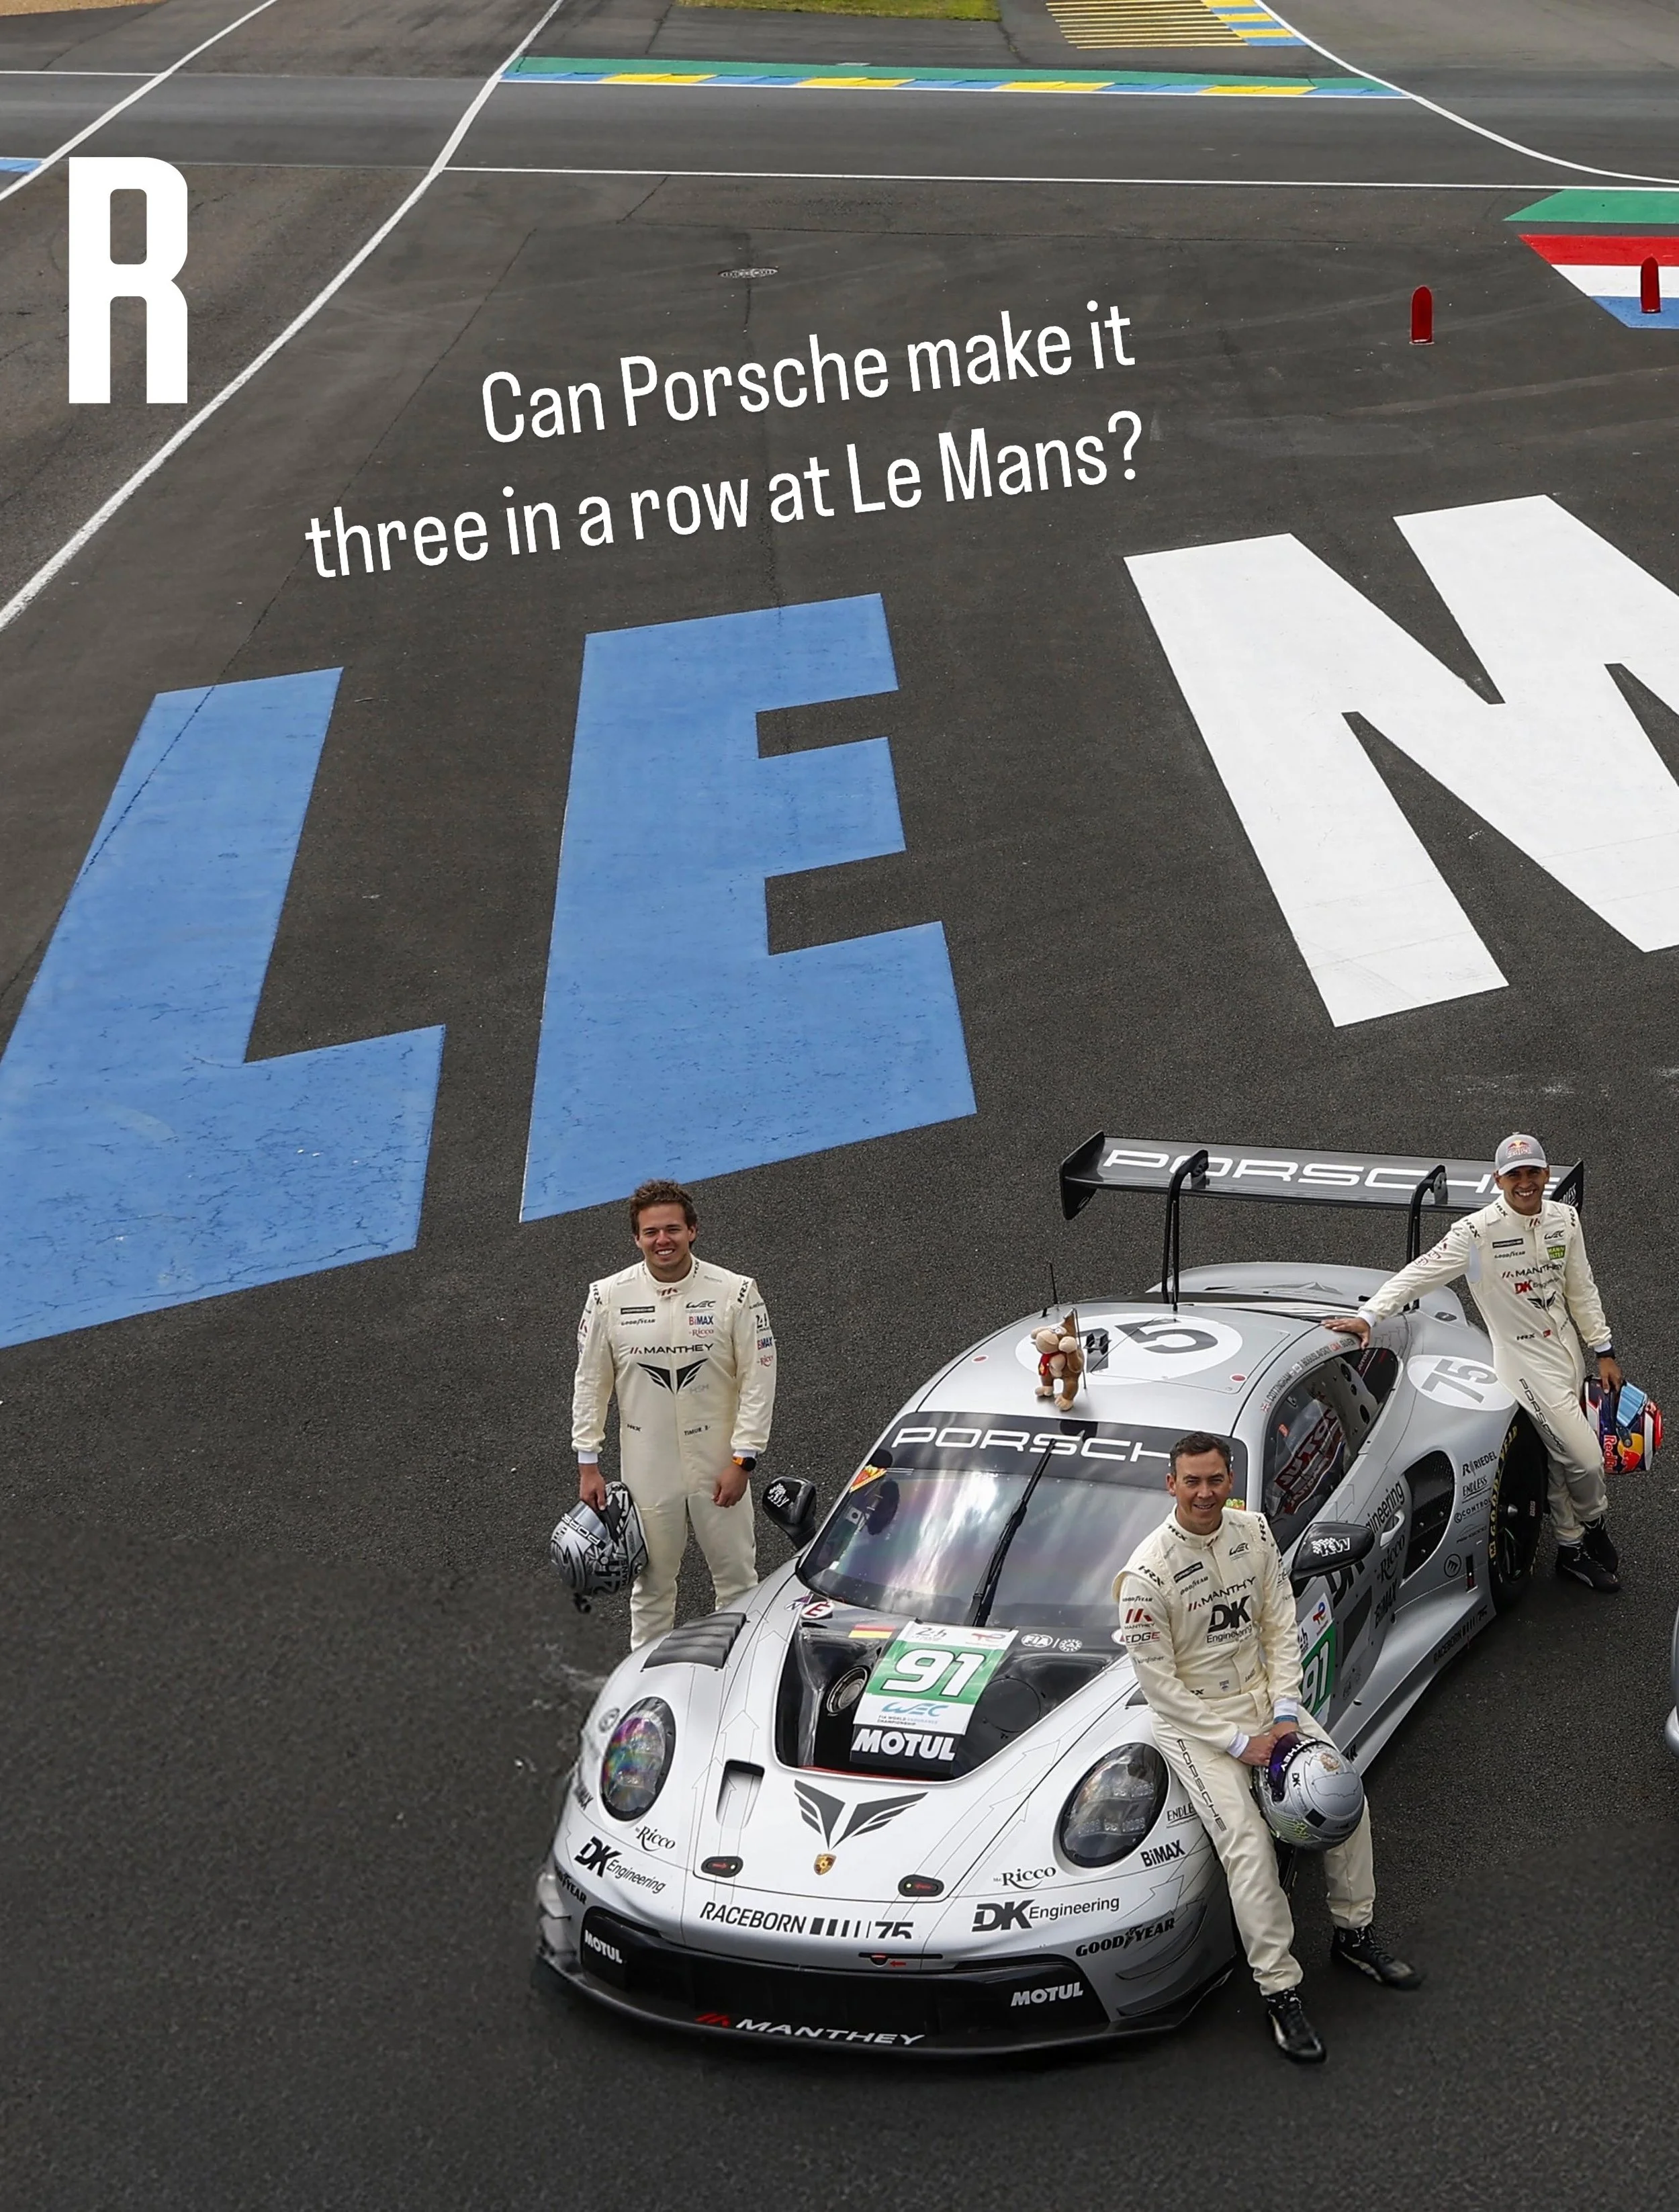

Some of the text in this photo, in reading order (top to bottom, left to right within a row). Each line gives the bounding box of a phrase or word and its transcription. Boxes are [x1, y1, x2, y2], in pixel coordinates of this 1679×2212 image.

[0, 594, 976, 1347] LE
[737, 1280, 750, 1304] HRX
[1514, 1279, 1533, 1294] DK
[686, 1300, 716, 1309] WEC
[689, 1315, 714, 1325] BiMAX
[644, 1343, 713, 1354] MANTHEY
[1421, 1358, 1499, 1403] 75
[891, 1427, 1172, 1467] PORSCH
[1473, 1451, 1497, 1470] RIEDEL
[1208, 1595, 1251, 1634] DK
[1126, 1631, 1161, 1644] EDGE
[880, 1648, 986, 1697] 91
[882, 1701, 949, 1717] WEC
[851, 1728, 956, 1761] MOTUL
[637, 1825, 676, 1852] Ricco
[574, 1835, 666, 1894] DK Engineering
[1140, 1839, 1186, 1868] BiMAX
[1001, 1867, 1056, 1890] Ricco
[700, 1901, 915, 1939] RACEBORN 75
[971, 1897, 1120, 1933] DK Engineering
[584, 1929, 623, 1964] MOTUL
[1075, 1918, 1176, 1957] GOODYEAR
[1011, 1982, 1083, 2007] MOTUL
[736, 2018, 925, 2046] MANTHEY
